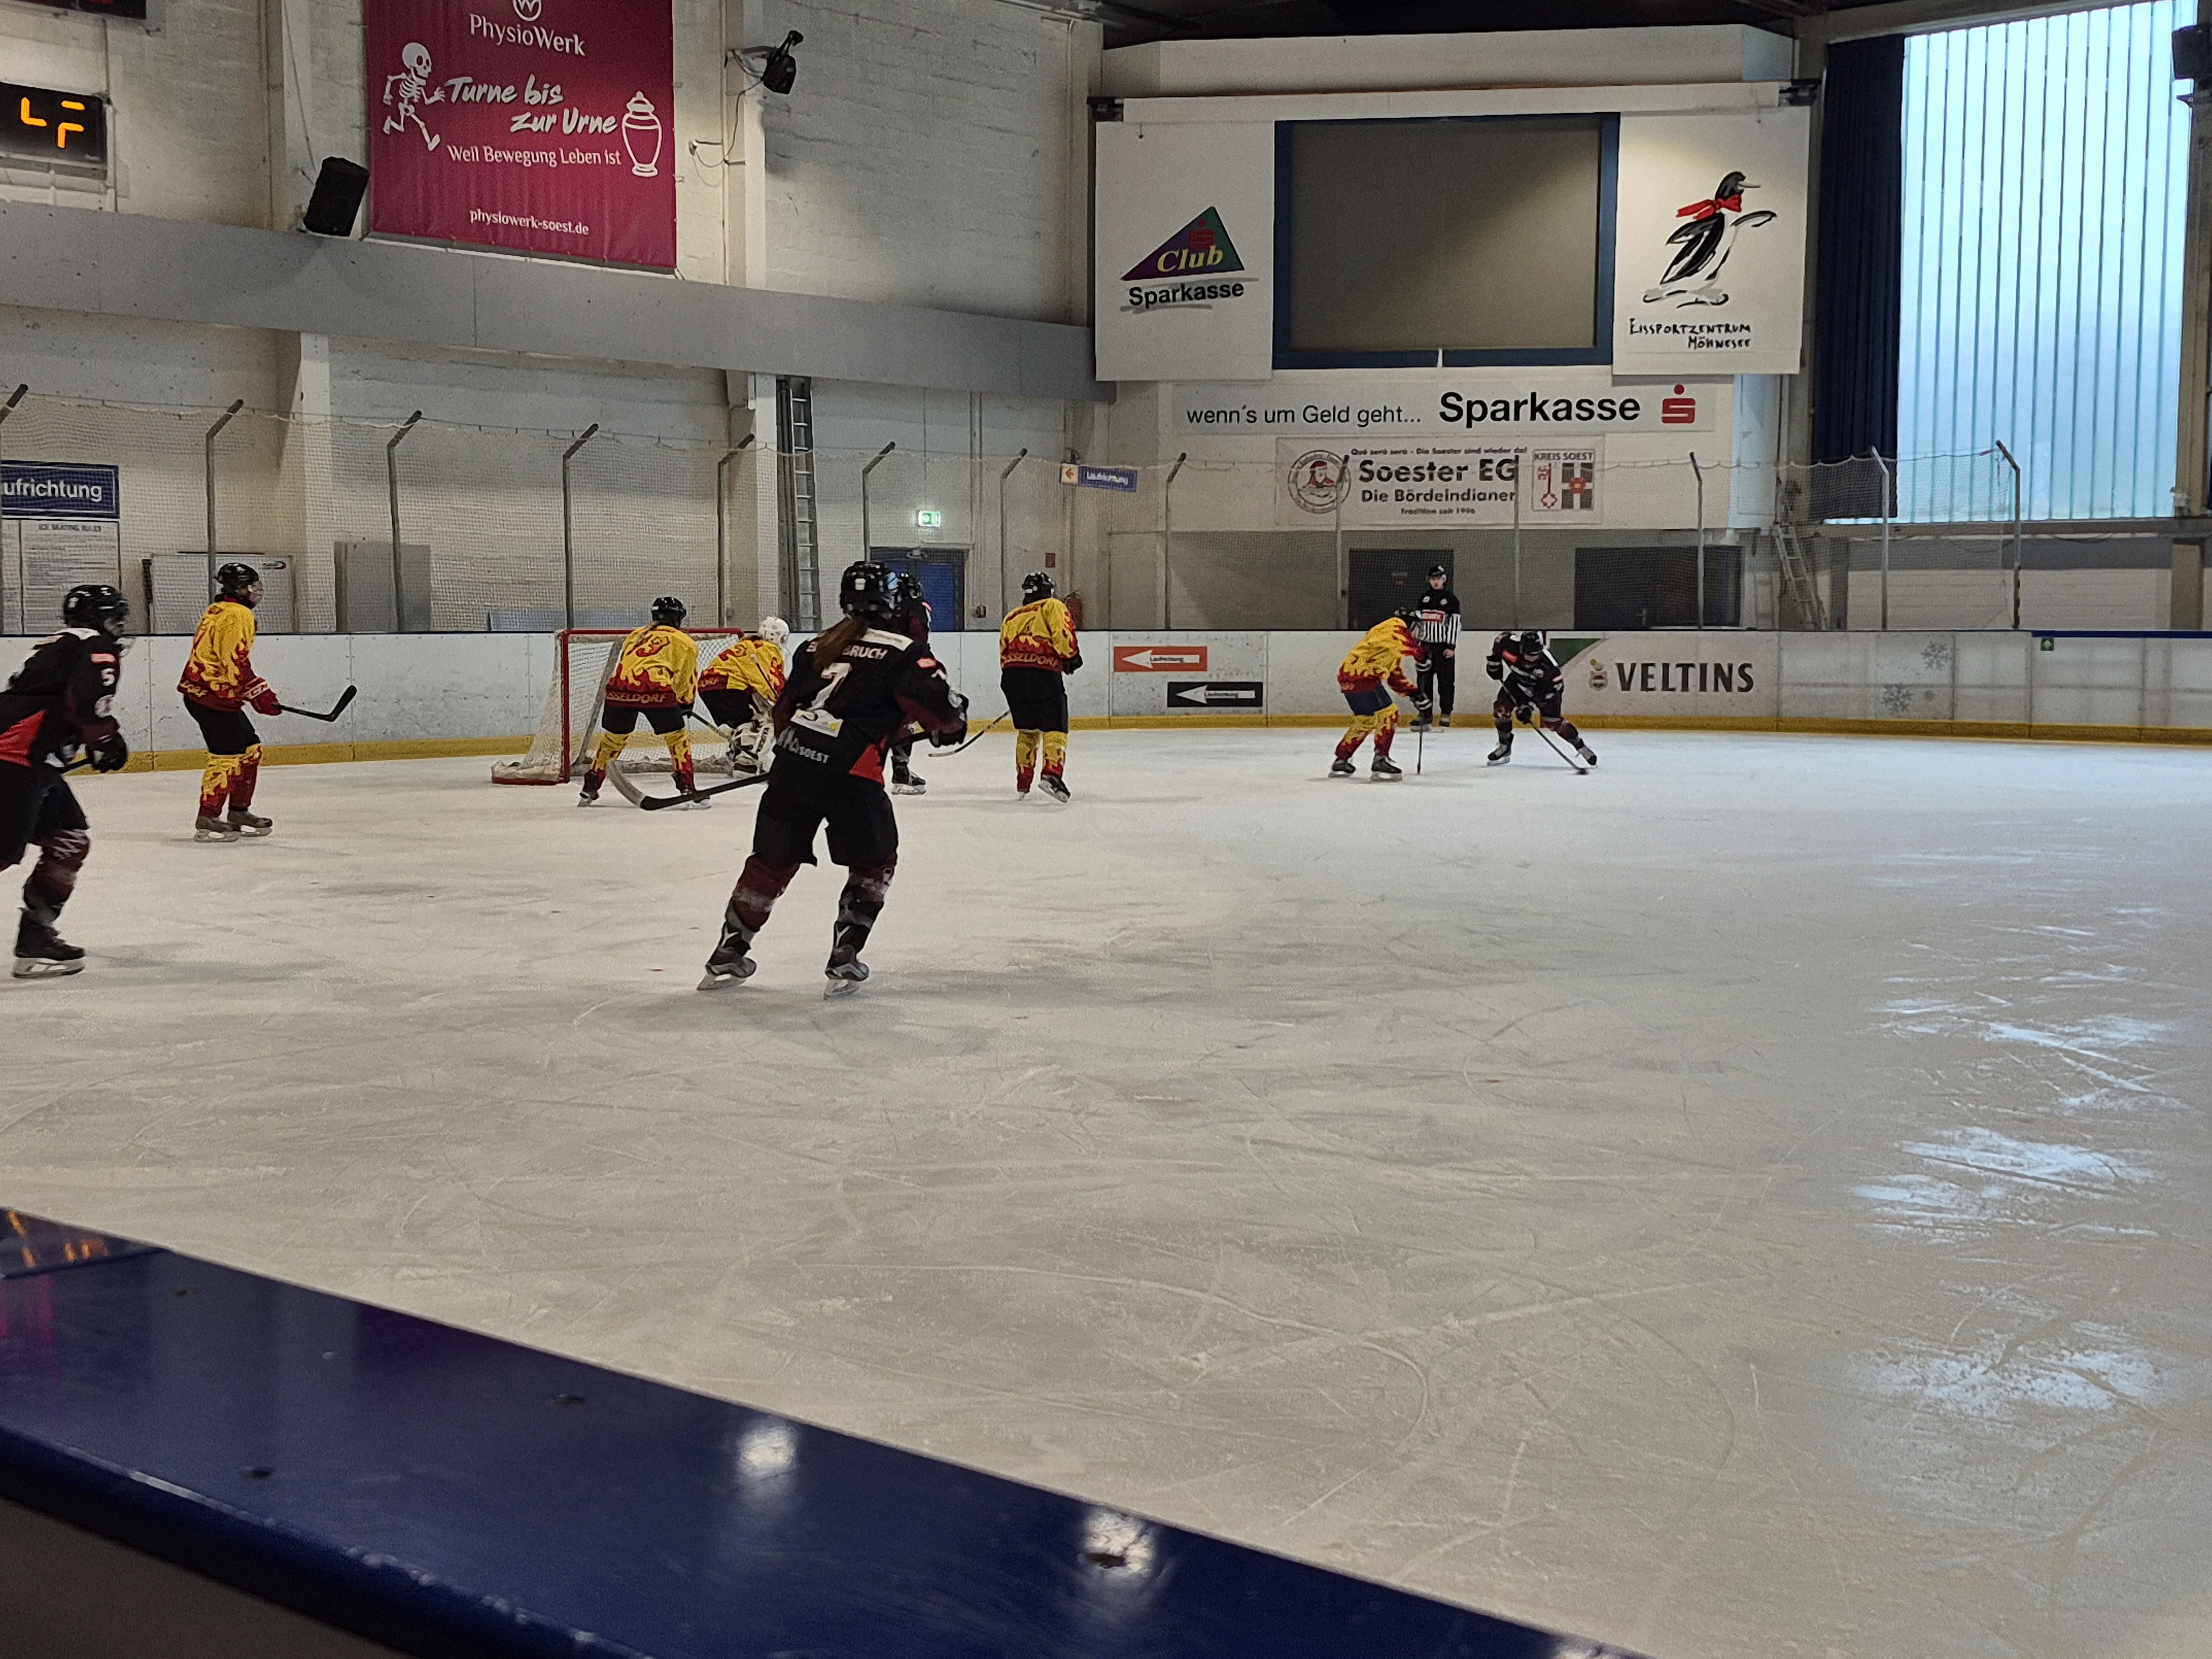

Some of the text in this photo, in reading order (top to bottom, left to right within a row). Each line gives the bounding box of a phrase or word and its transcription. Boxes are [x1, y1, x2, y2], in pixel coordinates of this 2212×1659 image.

[469, 13, 585, 56] PhysioWerk
[445, 74, 564, 105] Turne bis
[562, 107, 618, 134] Urne
[483, 145, 557, 167] Bewegung
[560, 148, 601, 165] Leben
[604, 149, 621, 165] ist
[469, 208, 589, 236] physiowerk-soest.de
[1157, 245, 1223, 272] Club
[1129, 283, 1244, 309] Sparkasse
[1265, 410, 1295, 424] um
[1302, 405, 1350, 423] Geld
[1357, 405, 1421, 427] geht...
[1439, 392, 1641, 429] Sparkasse
[1534, 452, 1593, 461] KREIS SOEST
[1359, 458, 1517, 483] Soester EG
[1361, 489, 1389, 502] Die
[101, 667, 116, 686] 5
[806, 662, 852, 711] 7
[1615, 662, 1754, 692] VELTINS
